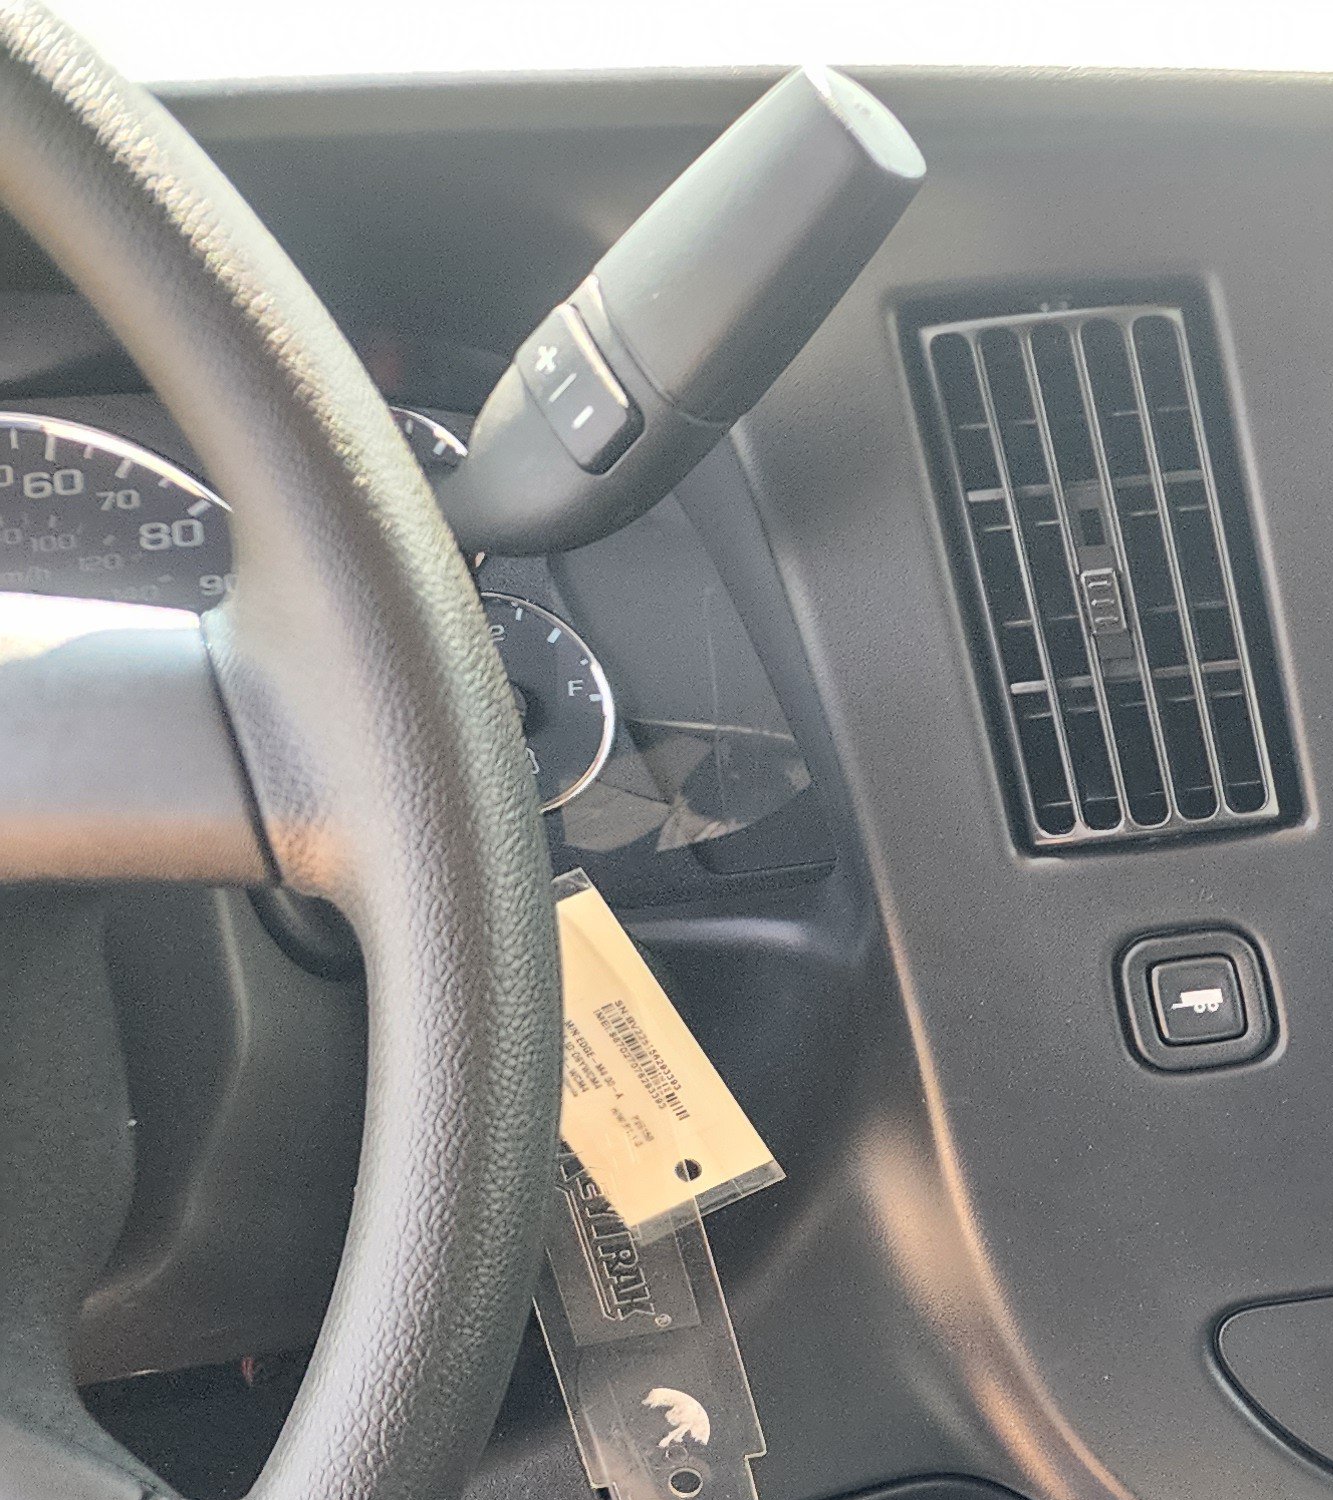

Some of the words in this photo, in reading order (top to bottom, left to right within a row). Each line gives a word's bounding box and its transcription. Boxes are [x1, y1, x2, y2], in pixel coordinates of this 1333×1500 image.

[23, 469, 84, 498] 60
[96, 490, 140, 511] 70
[139, 519, 203, 551] 80
[568, 680, 583, 696] F
